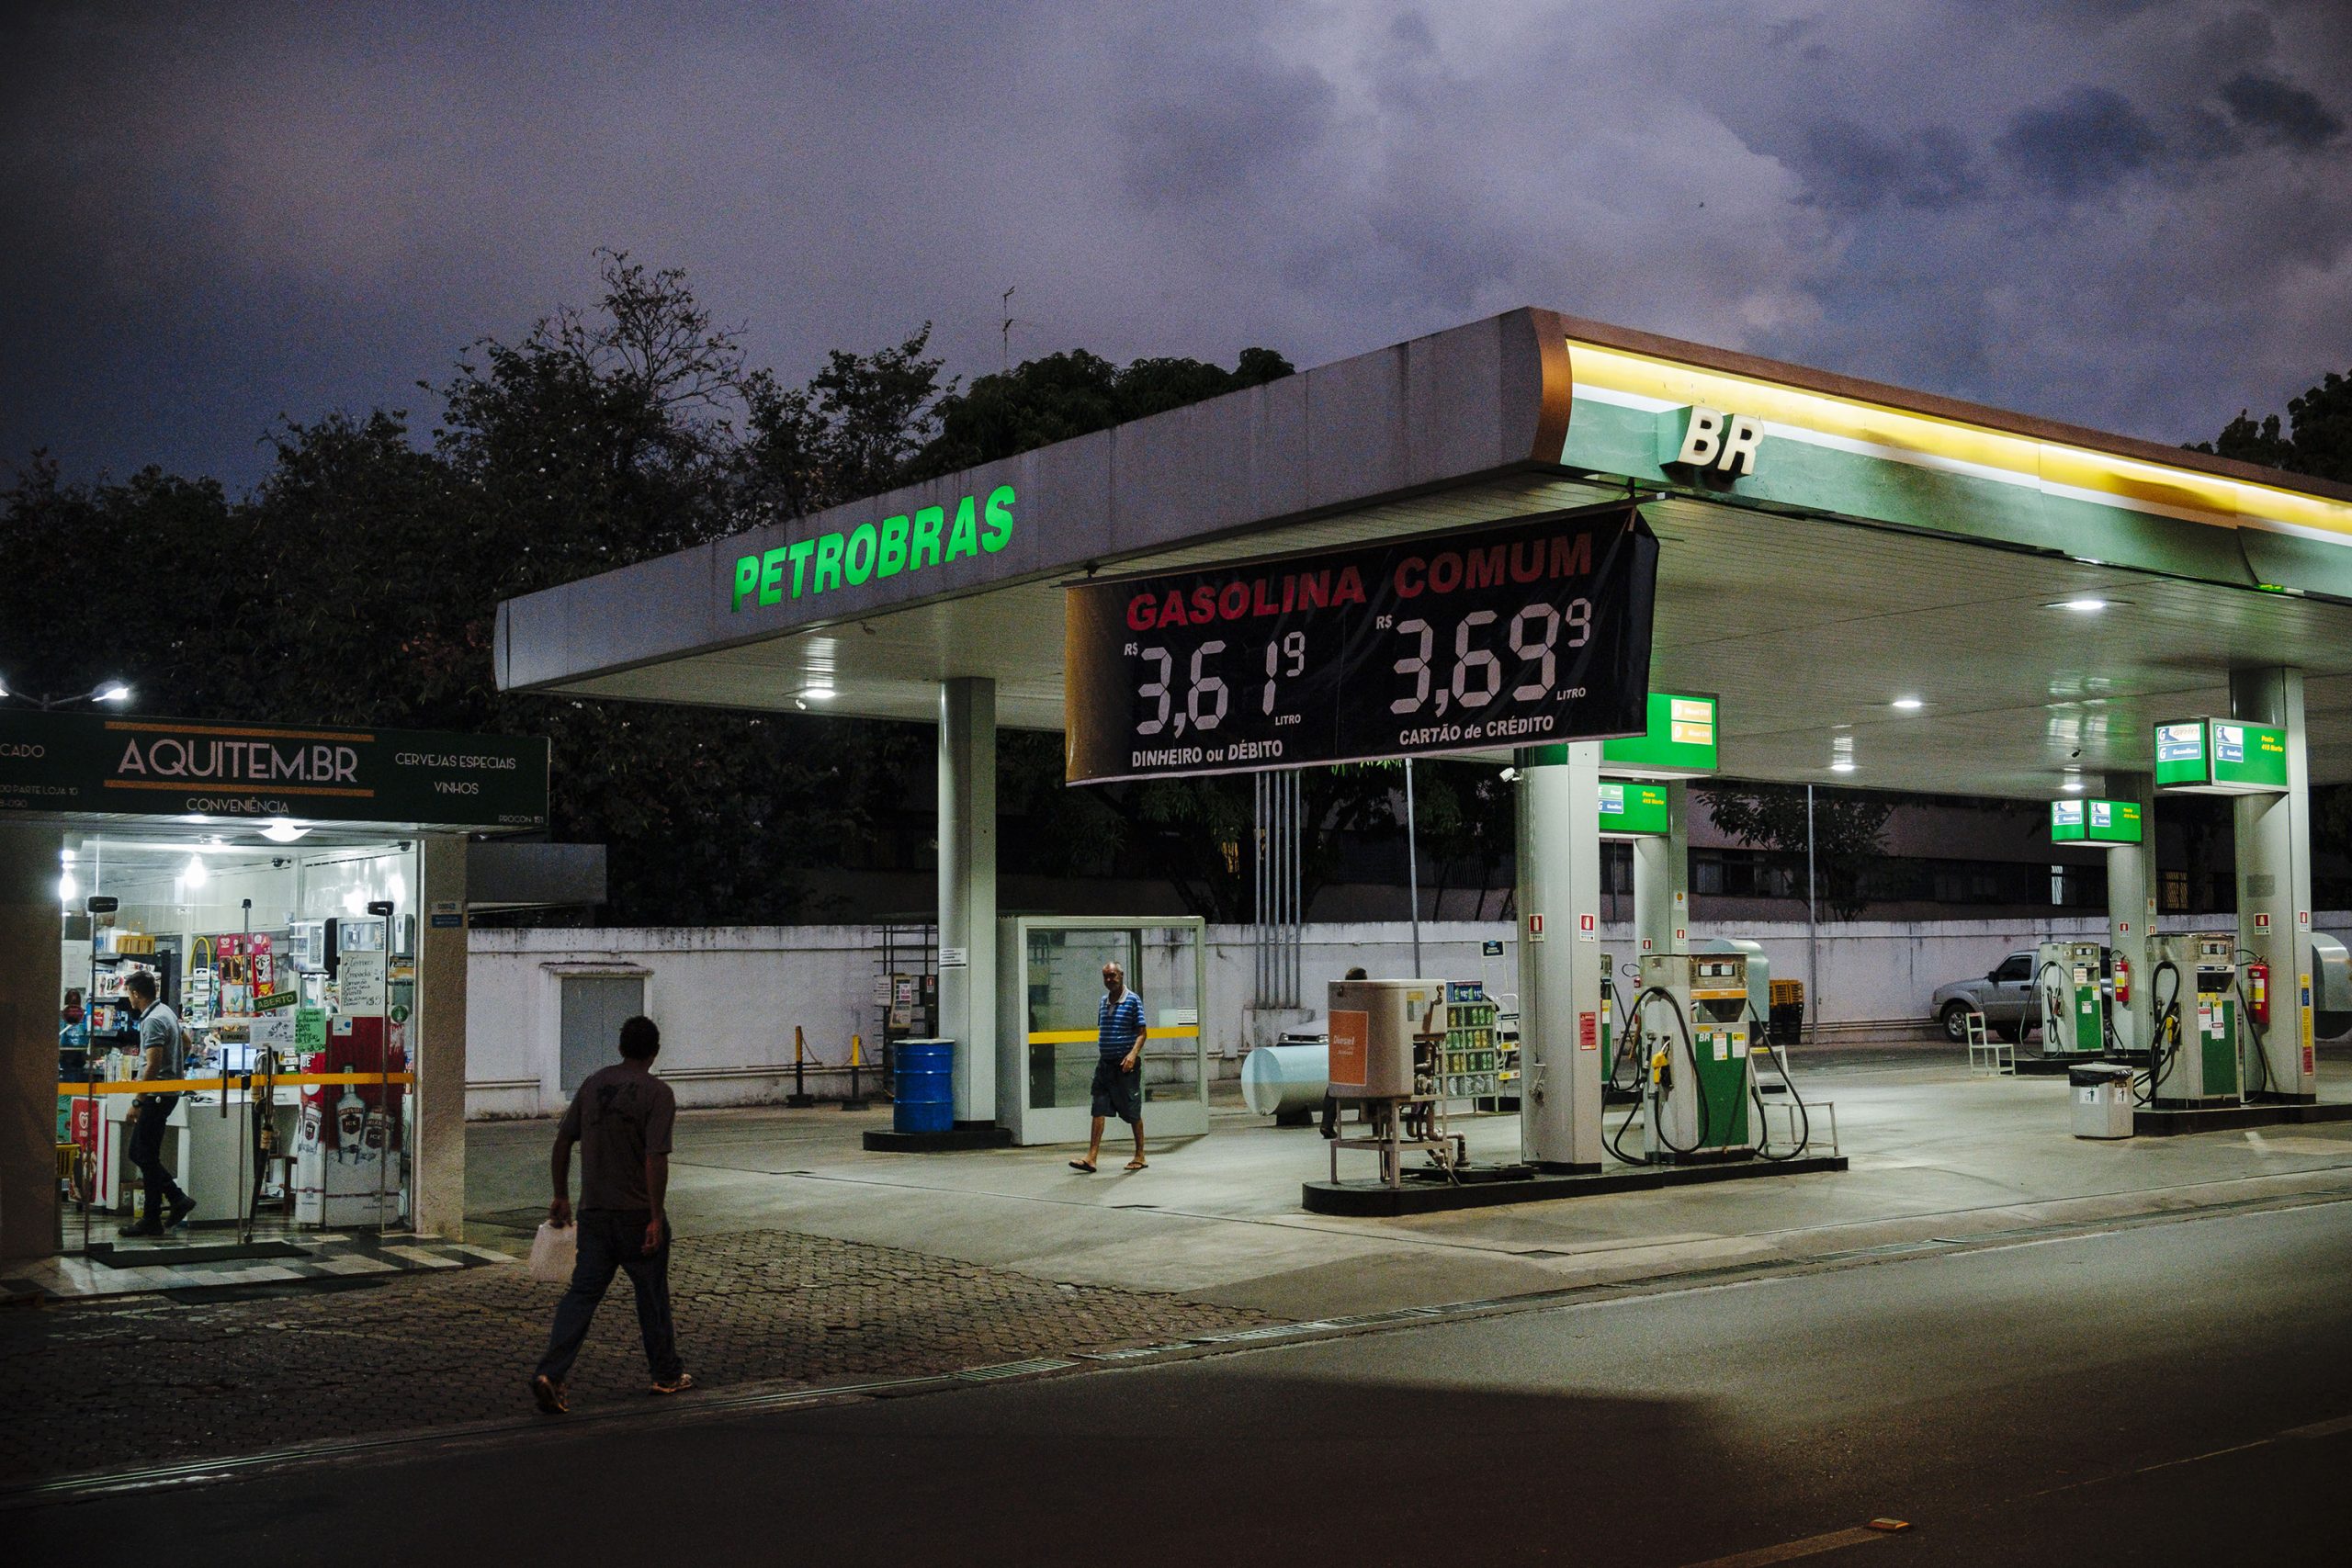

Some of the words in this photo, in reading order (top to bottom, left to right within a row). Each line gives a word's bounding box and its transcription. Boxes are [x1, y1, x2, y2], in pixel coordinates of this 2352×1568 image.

[1678, 405, 1765, 474] BR
[731, 485, 1015, 614] PETROBRAS
[1126, 566, 1367, 630] GASOLINA
[1394, 531, 1592, 598] COMUM
[1376, 615, 1392, 630] R$
[1124, 642, 1138, 656] R$
[1556, 687, 1586, 701] LITRO
[1274, 714, 1301, 726] LITRO
[1399, 724, 1460, 746] CARTÃO
[1464, 725, 1481, 739] de
[1487, 715, 1554, 737] CRÉDITO
[1132, 747, 1202, 767] DINHEIRO
[1206, 749, 1223, 762] ou
[1228, 739, 1283, 760] DÉBITO
[395, 752, 457, 767] CERVEJAS
[459, 756, 516, 770] ESPECIAIS
[13, 784, 40, 795] PARTE
[42, 786, 66, 795] LOJA
[435, 782, 479, 795] VINHOS
[187, 796, 289, 814] CONVENIÊNCIA
[498, 815, 532, 823] PROCON
[258, 994, 294, 1008] ABERTO
[1699, 1033, 1710, 1042] BR
